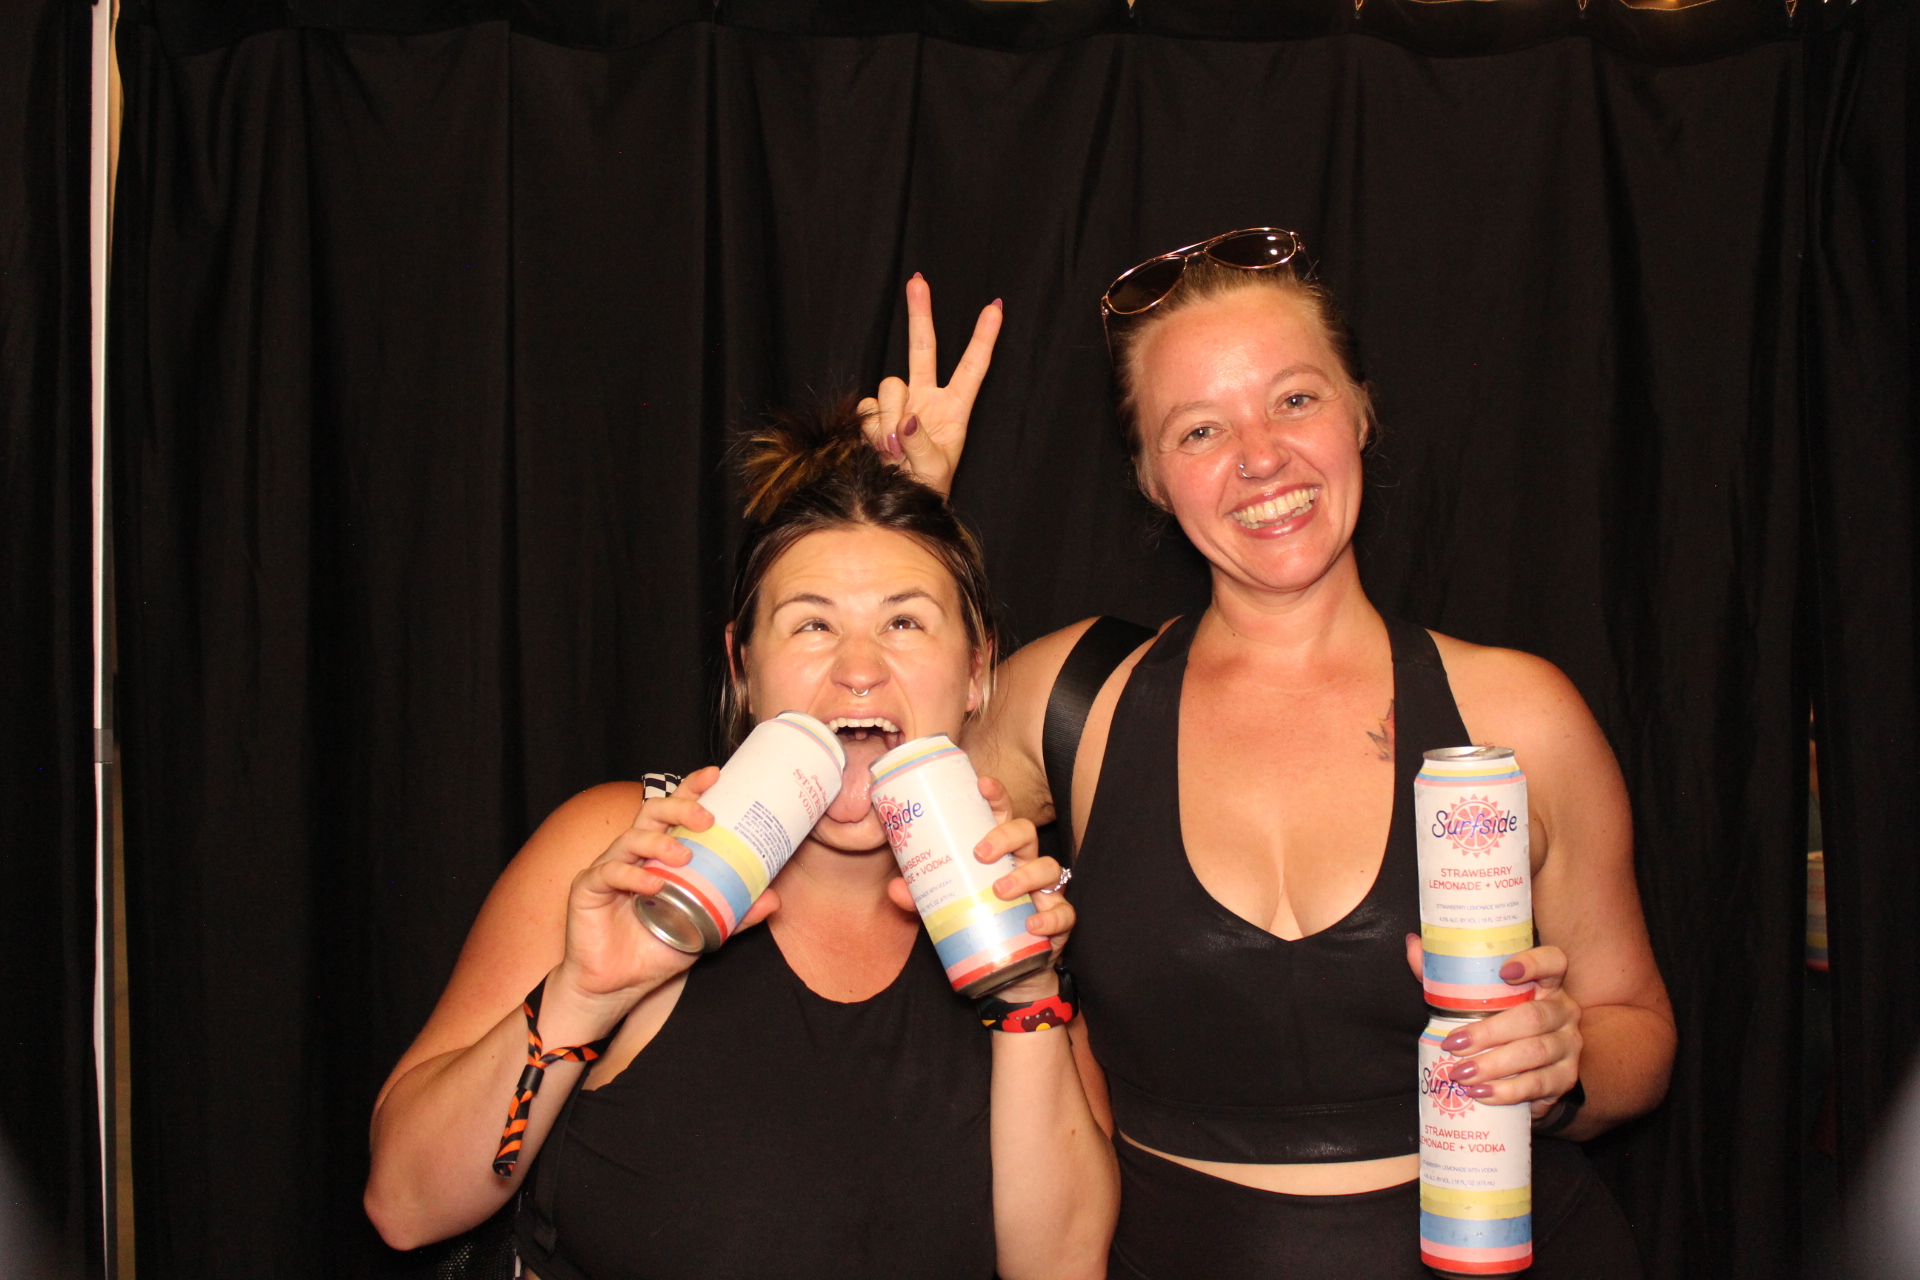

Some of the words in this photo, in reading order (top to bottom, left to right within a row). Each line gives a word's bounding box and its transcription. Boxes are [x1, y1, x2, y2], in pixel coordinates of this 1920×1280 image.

[1431, 810, 1518, 838] Surfside
[920, 855, 953, 875] VODKA
[1441, 866, 1512, 878] STRAWBERRY
[1429, 879, 1482, 891] LEMONADE
[1494, 877, 1524, 889] VODKA
[1421, 1067, 1469, 1099] Surfs
[1425, 1124, 1490, 1140] STRAWBERRY
[1420, 1136, 1456, 1151] EMONADE
[1469, 1143, 1506, 1153] VODKA
